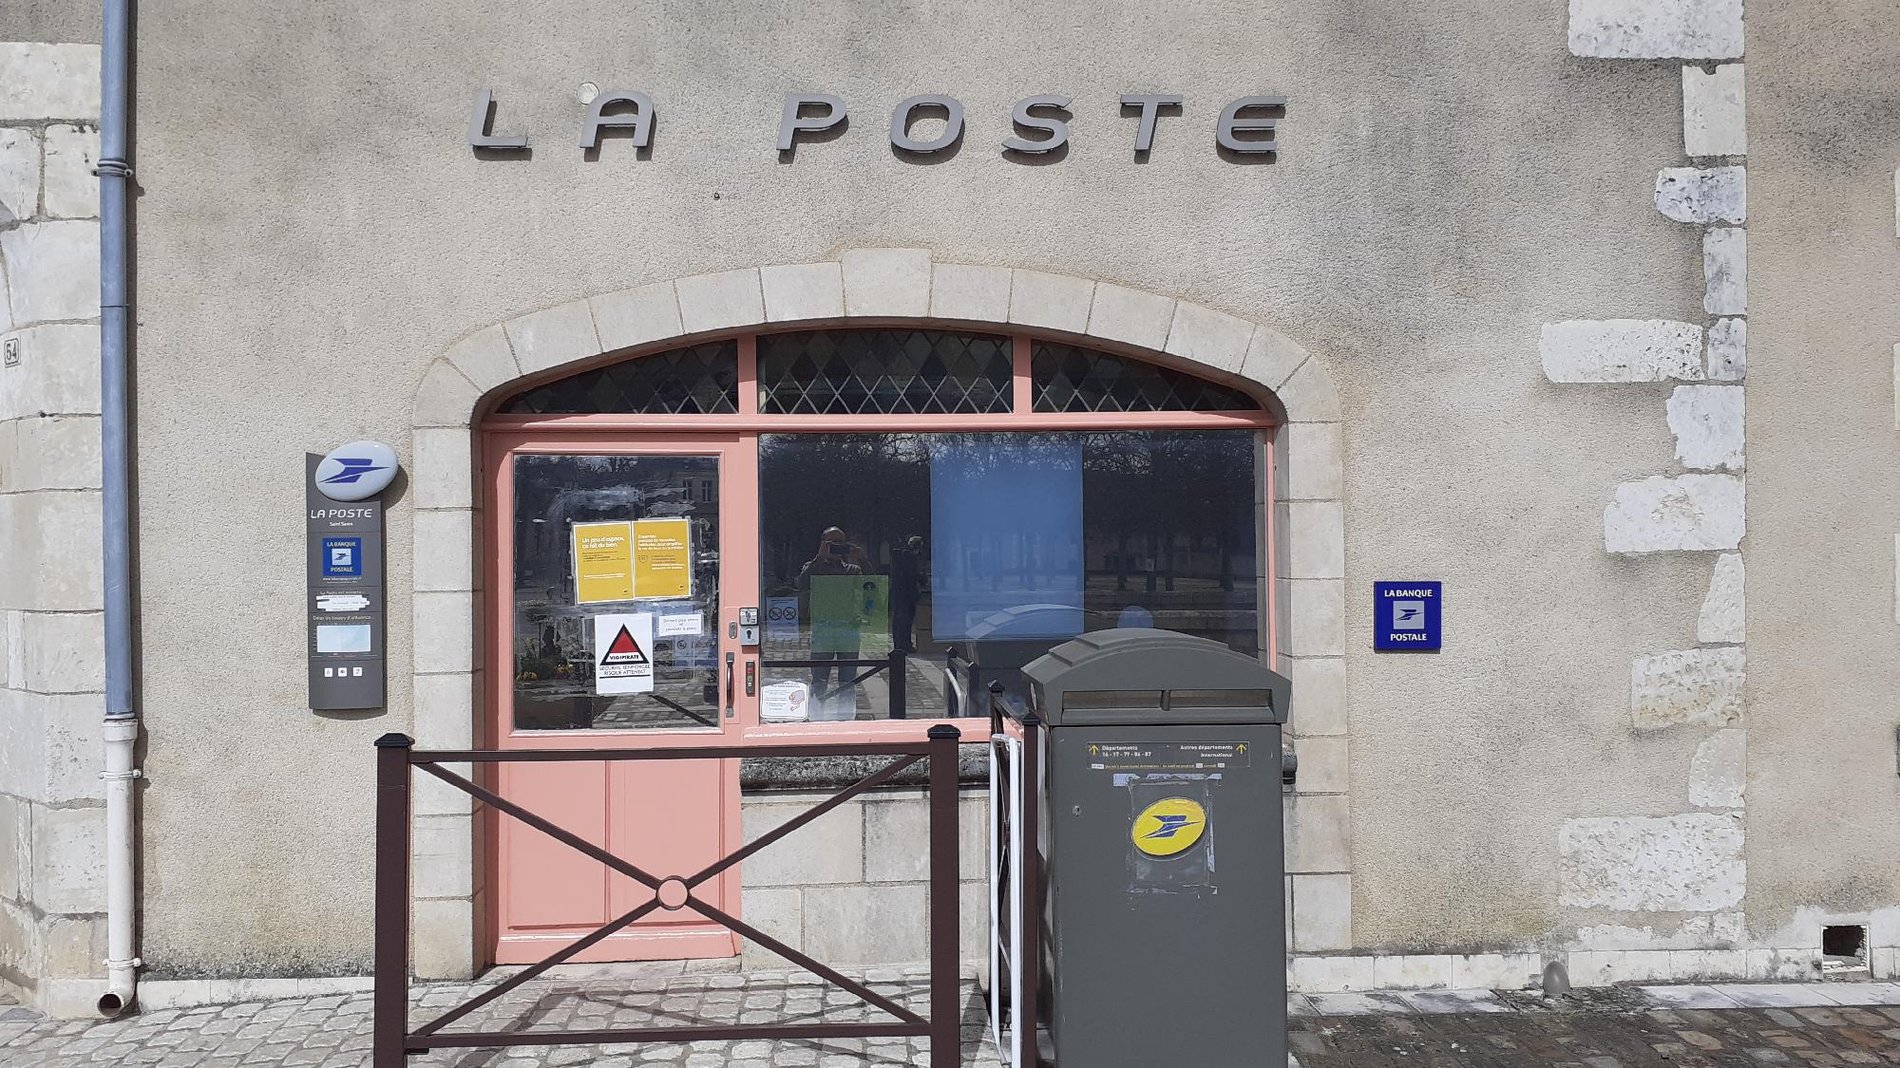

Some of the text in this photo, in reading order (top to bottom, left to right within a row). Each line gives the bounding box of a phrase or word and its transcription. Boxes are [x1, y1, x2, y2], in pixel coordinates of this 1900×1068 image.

[467, 89, 1288, 154] LA POSTE
[6, 341, 17, 360] 54
[310, 508, 373, 519] LA POSTE
[1396, 589, 1433, 598] BANQUE
[1390, 633, 1427, 641] POSTALE
